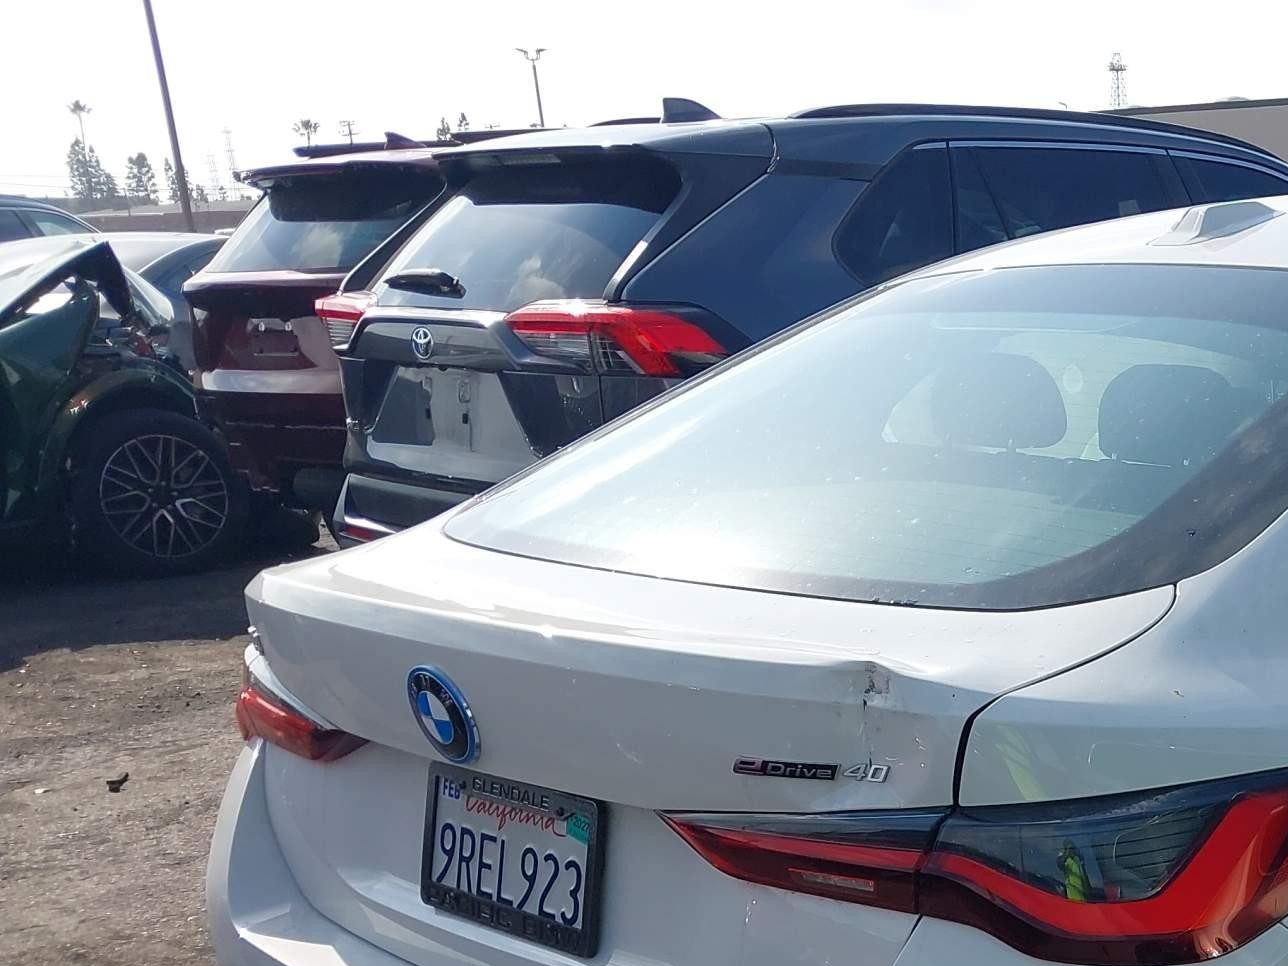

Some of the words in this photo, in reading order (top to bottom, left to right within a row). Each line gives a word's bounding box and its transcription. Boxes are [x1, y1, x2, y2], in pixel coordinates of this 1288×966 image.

[734, 757, 838, 780] eDrive
[843, 763, 891, 783] 40
[472, 777, 551, 812] GLENDALE
[435, 822, 583, 927] 9REL923
